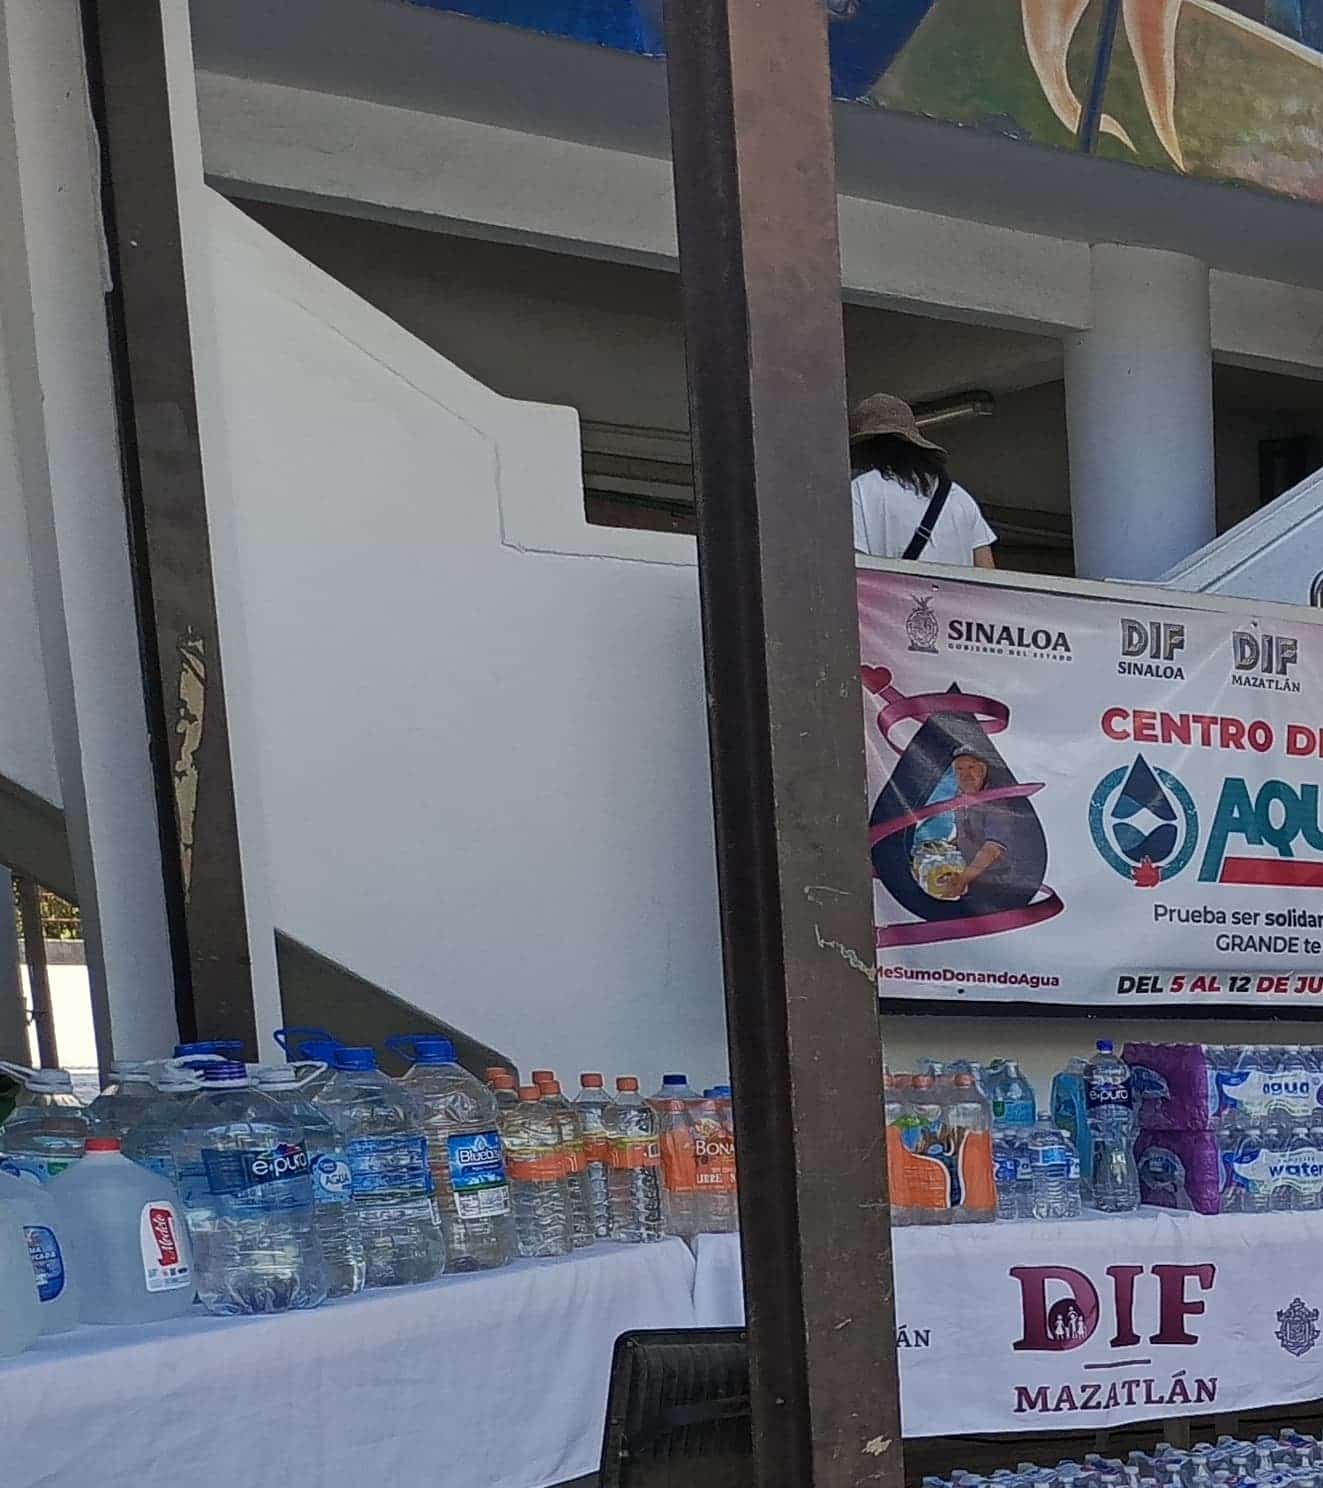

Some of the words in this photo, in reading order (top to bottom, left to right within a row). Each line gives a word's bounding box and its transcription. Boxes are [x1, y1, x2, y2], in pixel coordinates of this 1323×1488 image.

[948, 619, 1071, 652] SINALOA
[1120, 618, 1185, 661] DIF
[1232, 631, 1298, 675] DIF
[1118, 661, 1185, 680] SINALOA
[1231, 674, 1300, 693] MAZATLÁN
[1101, 707, 1274, 753] CENTRO
[1153, 904, 1226, 925] Prueba
[1231, 910, 1260, 926] ser
[1215, 934, 1300, 954] GRANDE
[1303, 939, 1321, 955] te
[1117, 975, 1164, 995] DEL
[1169, 975, 1186, 994] 5
[1189, 975, 1222, 993] AL
[1228, 975, 1251, 994] 12
[1256, 975, 1291, 995] DE
[1009, 1263, 1216, 1351] DIF
[1013, 1369, 1218, 1413] MAZATLÁN
